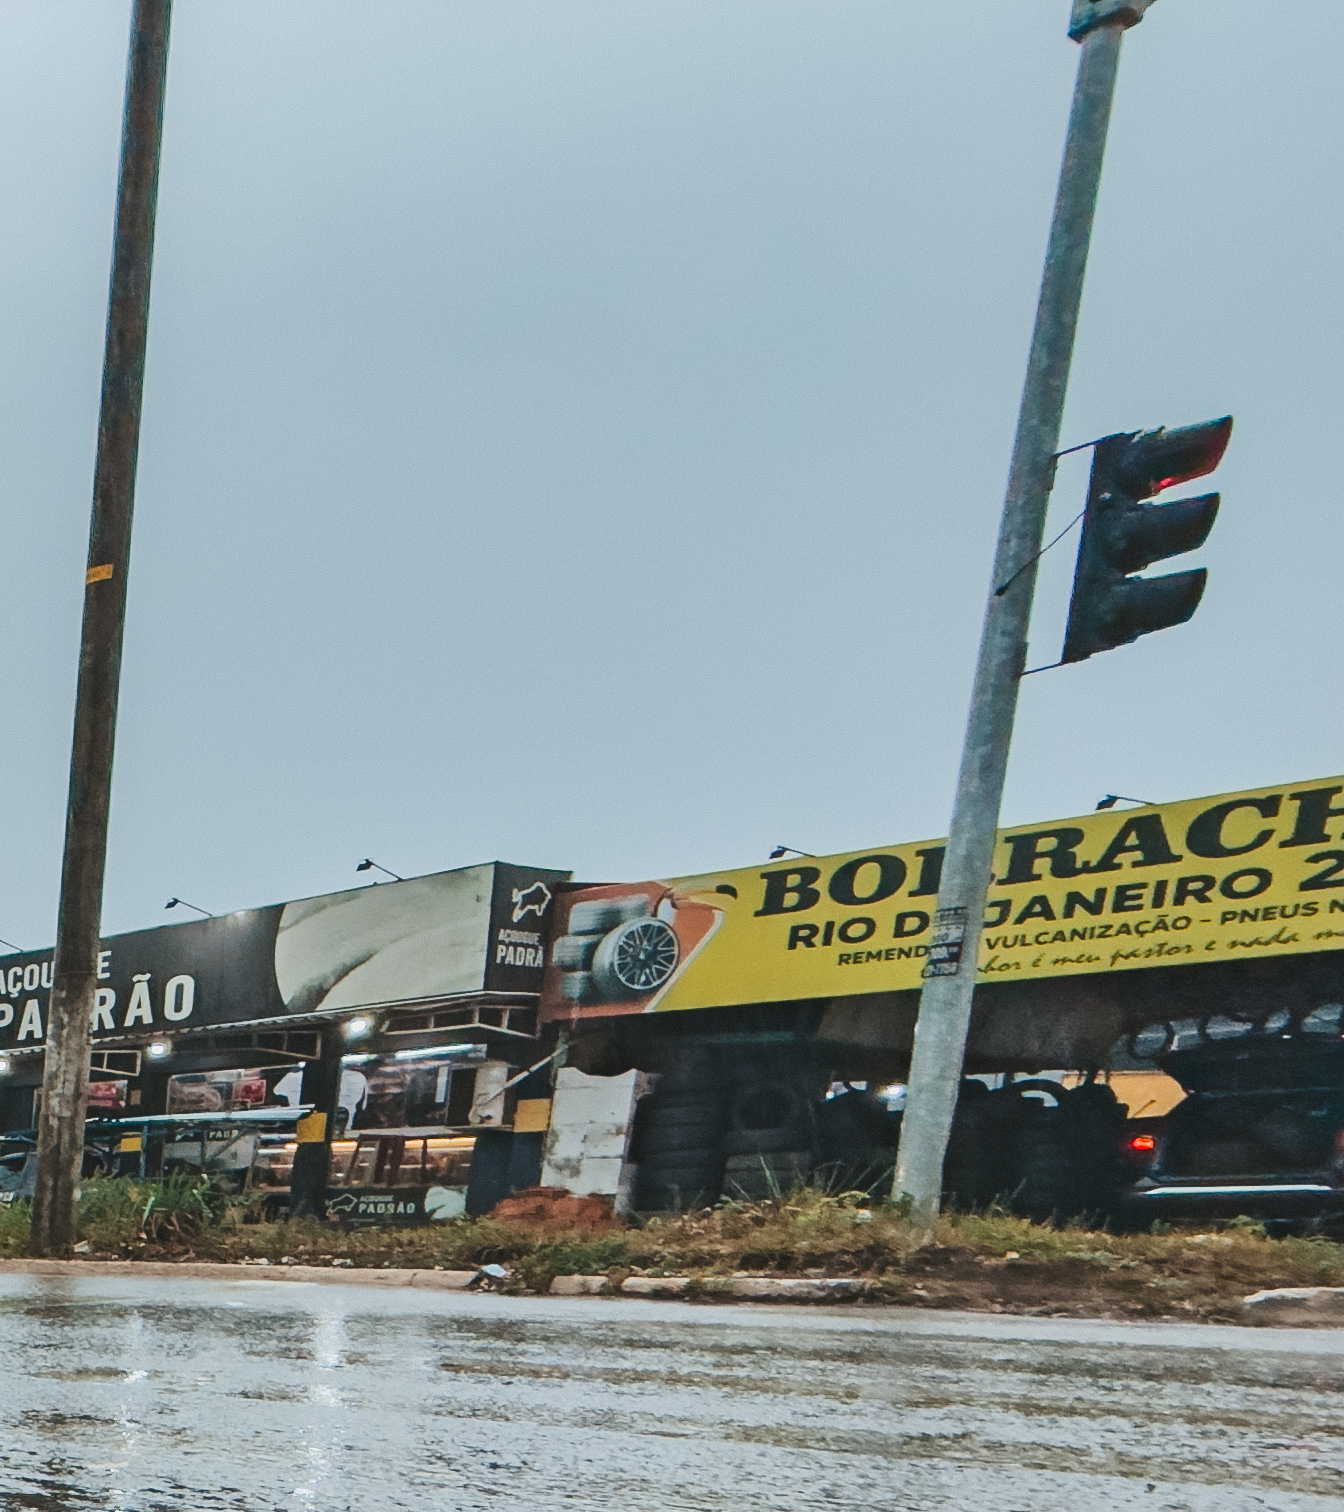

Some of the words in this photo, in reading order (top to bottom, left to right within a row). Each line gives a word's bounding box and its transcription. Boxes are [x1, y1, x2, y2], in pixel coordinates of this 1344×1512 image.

[787, 916, 877, 951] RIO
[892, 910, 931, 939] D
[982, 866, 1273, 929] JANEIRO
[985, 914, 1192, 951] VULCANIZAÇÃO
[1220, 900, 1319, 926] PNEUS
[1051, 953, 1102, 970] meu
[1110, 941, 1196, 967] pastor
[1225, 926, 1300, 949] nada
